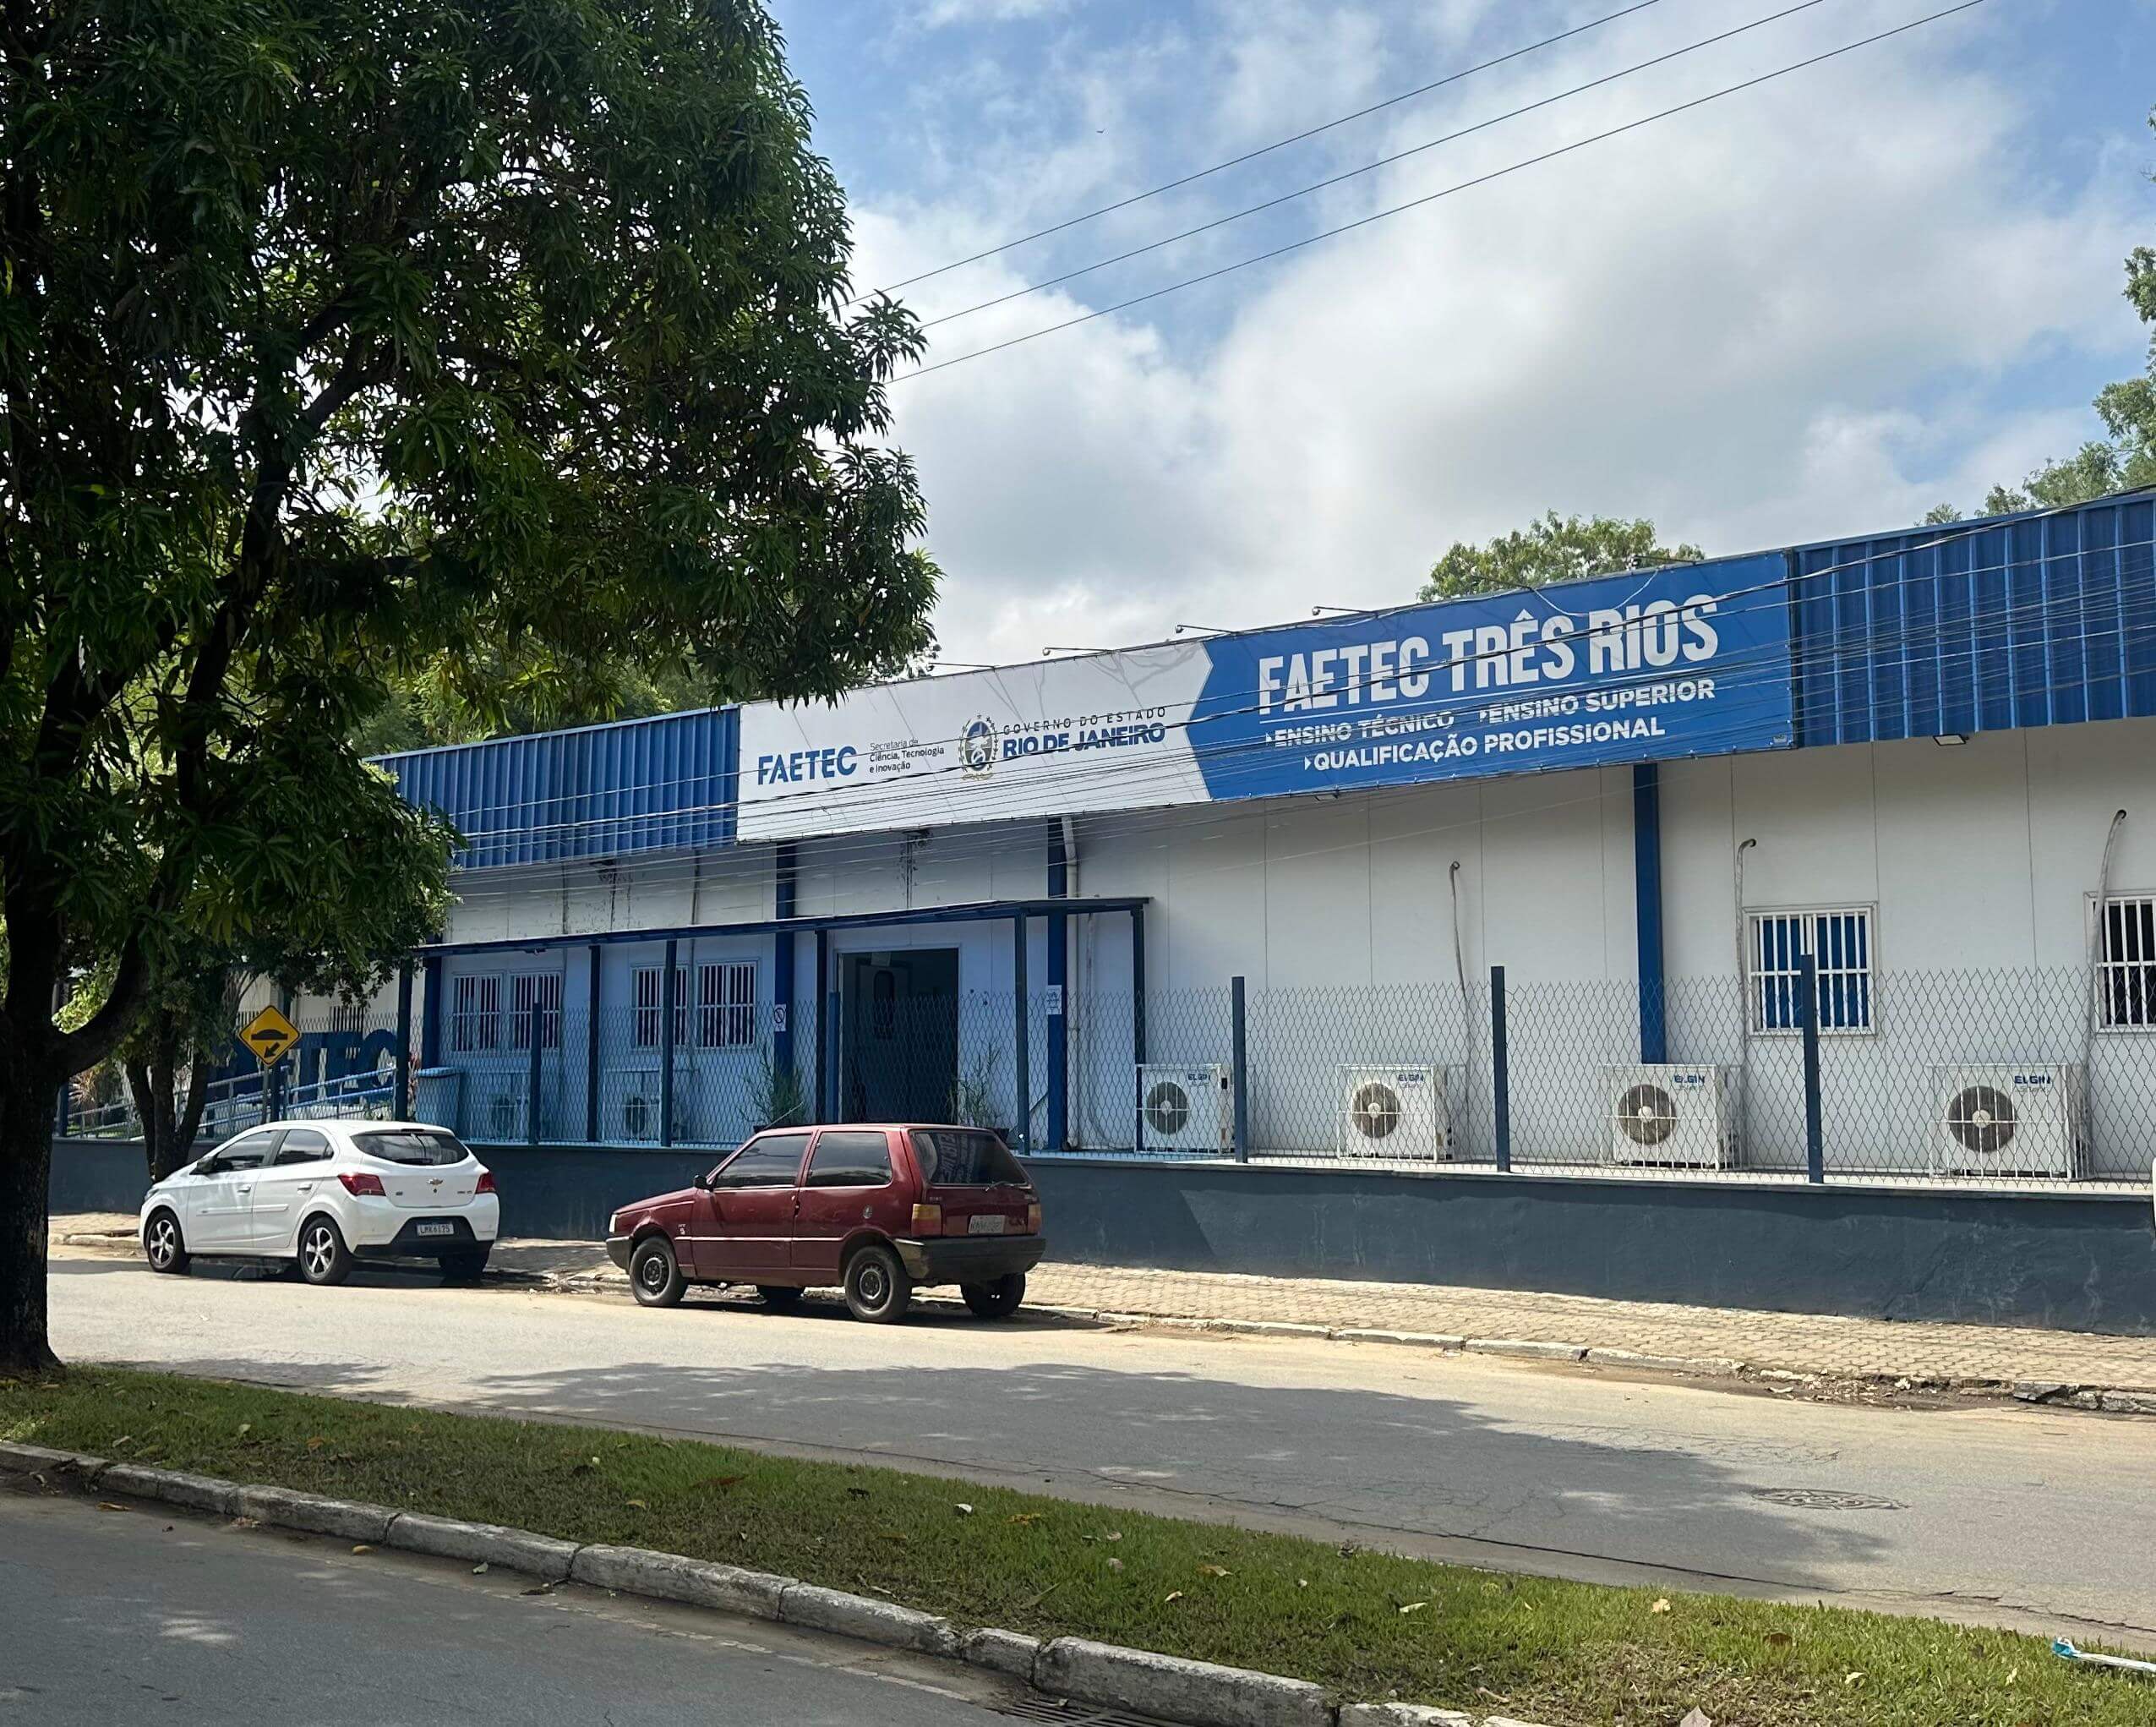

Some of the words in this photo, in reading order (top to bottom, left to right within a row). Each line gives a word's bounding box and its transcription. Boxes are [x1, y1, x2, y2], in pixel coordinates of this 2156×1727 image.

[1259, 637, 1429, 715] FAETEC
[1442, 611, 1575, 691] TRÊS
[1589, 594, 1718, 674] RIOS
[1003, 718, 1072, 735] GOVERNO
[1080, 714, 1098, 726] DO
[1107, 707, 1166, 724] ESTADO
[1274, 722, 1352, 747] ENSINO
[1357, 711, 1455, 738] TÉCNICO
[1489, 695, 1579, 724] ENSINO
[1586, 678, 1715, 713] SUPERIOR
[870, 739, 908, 751] Secretaria
[902, 746, 945, 759] Tecnologia
[1003, 736, 1040, 758] RIO
[1043, 733, 1070, 753] DE
[1074, 722, 1165, 751] JANEIRO
[1313, 734, 1478, 771] QUALIFICAÇÃO
[1484, 717, 1666, 754] PROFISSIONAL
[758, 746, 857, 784] FAETEC
[876, 761, 911, 773] Inovação
[2014, 1075, 2050, 1084] ELGIN
